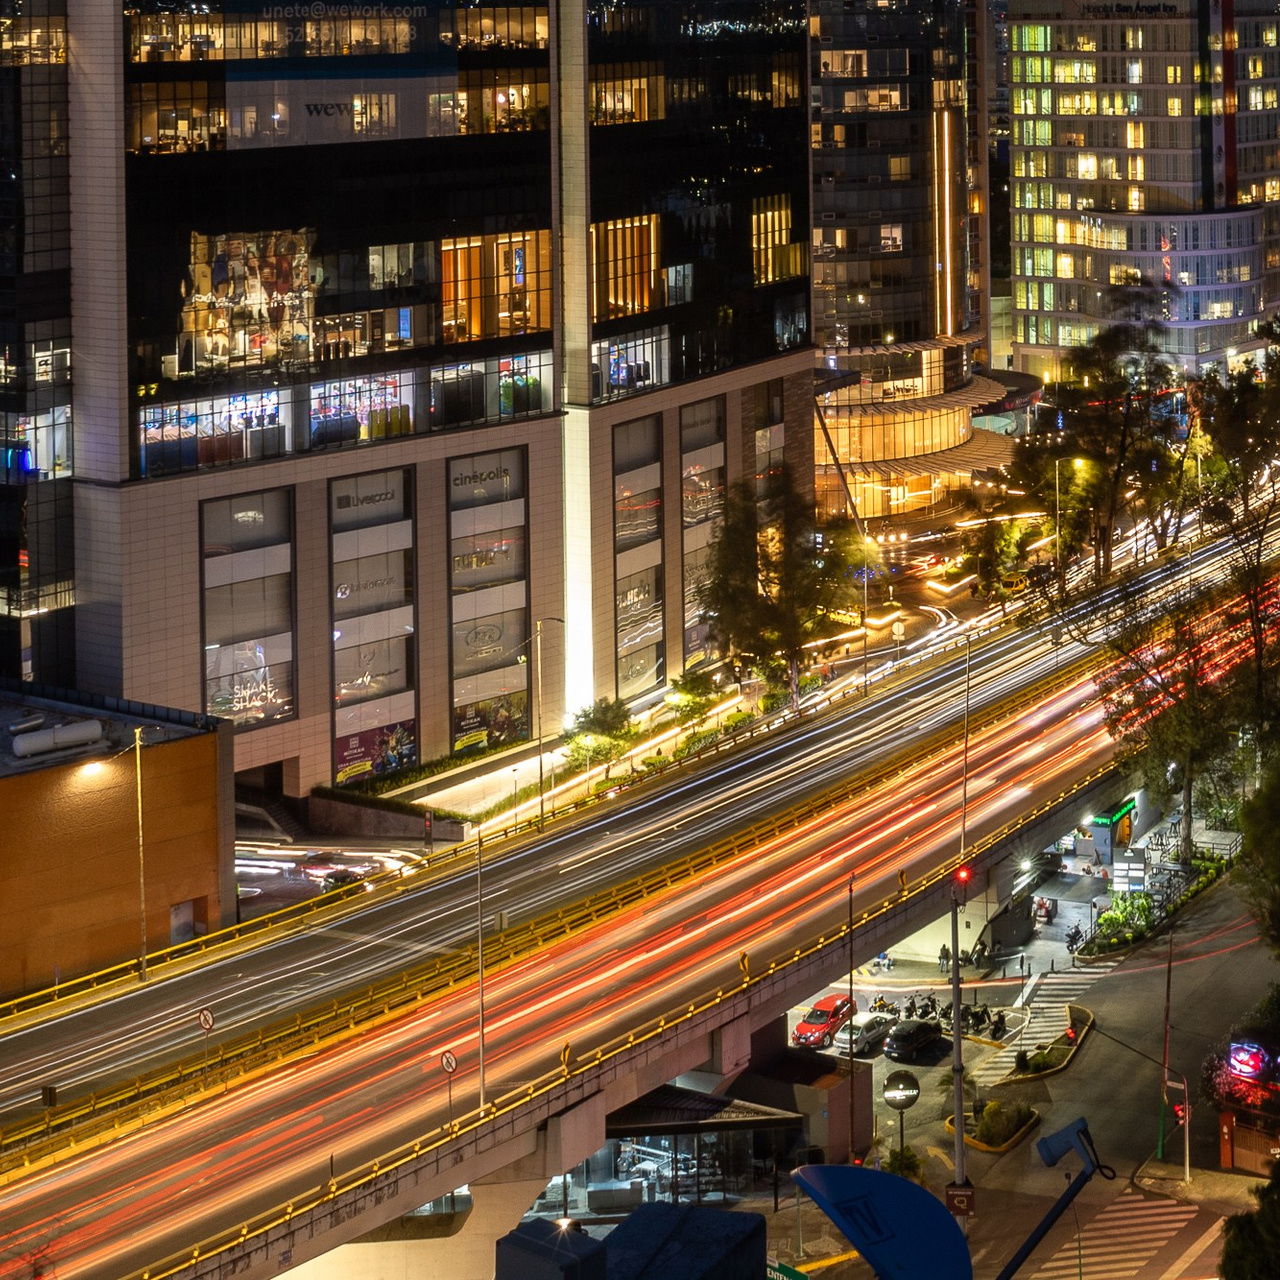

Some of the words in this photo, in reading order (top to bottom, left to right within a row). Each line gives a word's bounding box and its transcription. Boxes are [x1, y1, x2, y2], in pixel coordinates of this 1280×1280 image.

[262, 1, 427, 19] unete@wework.com
[1115, 3, 1133, 13] San
[1135, 1, 1161, 15] Ángel
[1162, 3, 1177, 13] Inn
[453, 467, 509, 487] cinépolis
[233, 677, 275, 698] SHAKE
[232, 690, 277, 711] SHACK
